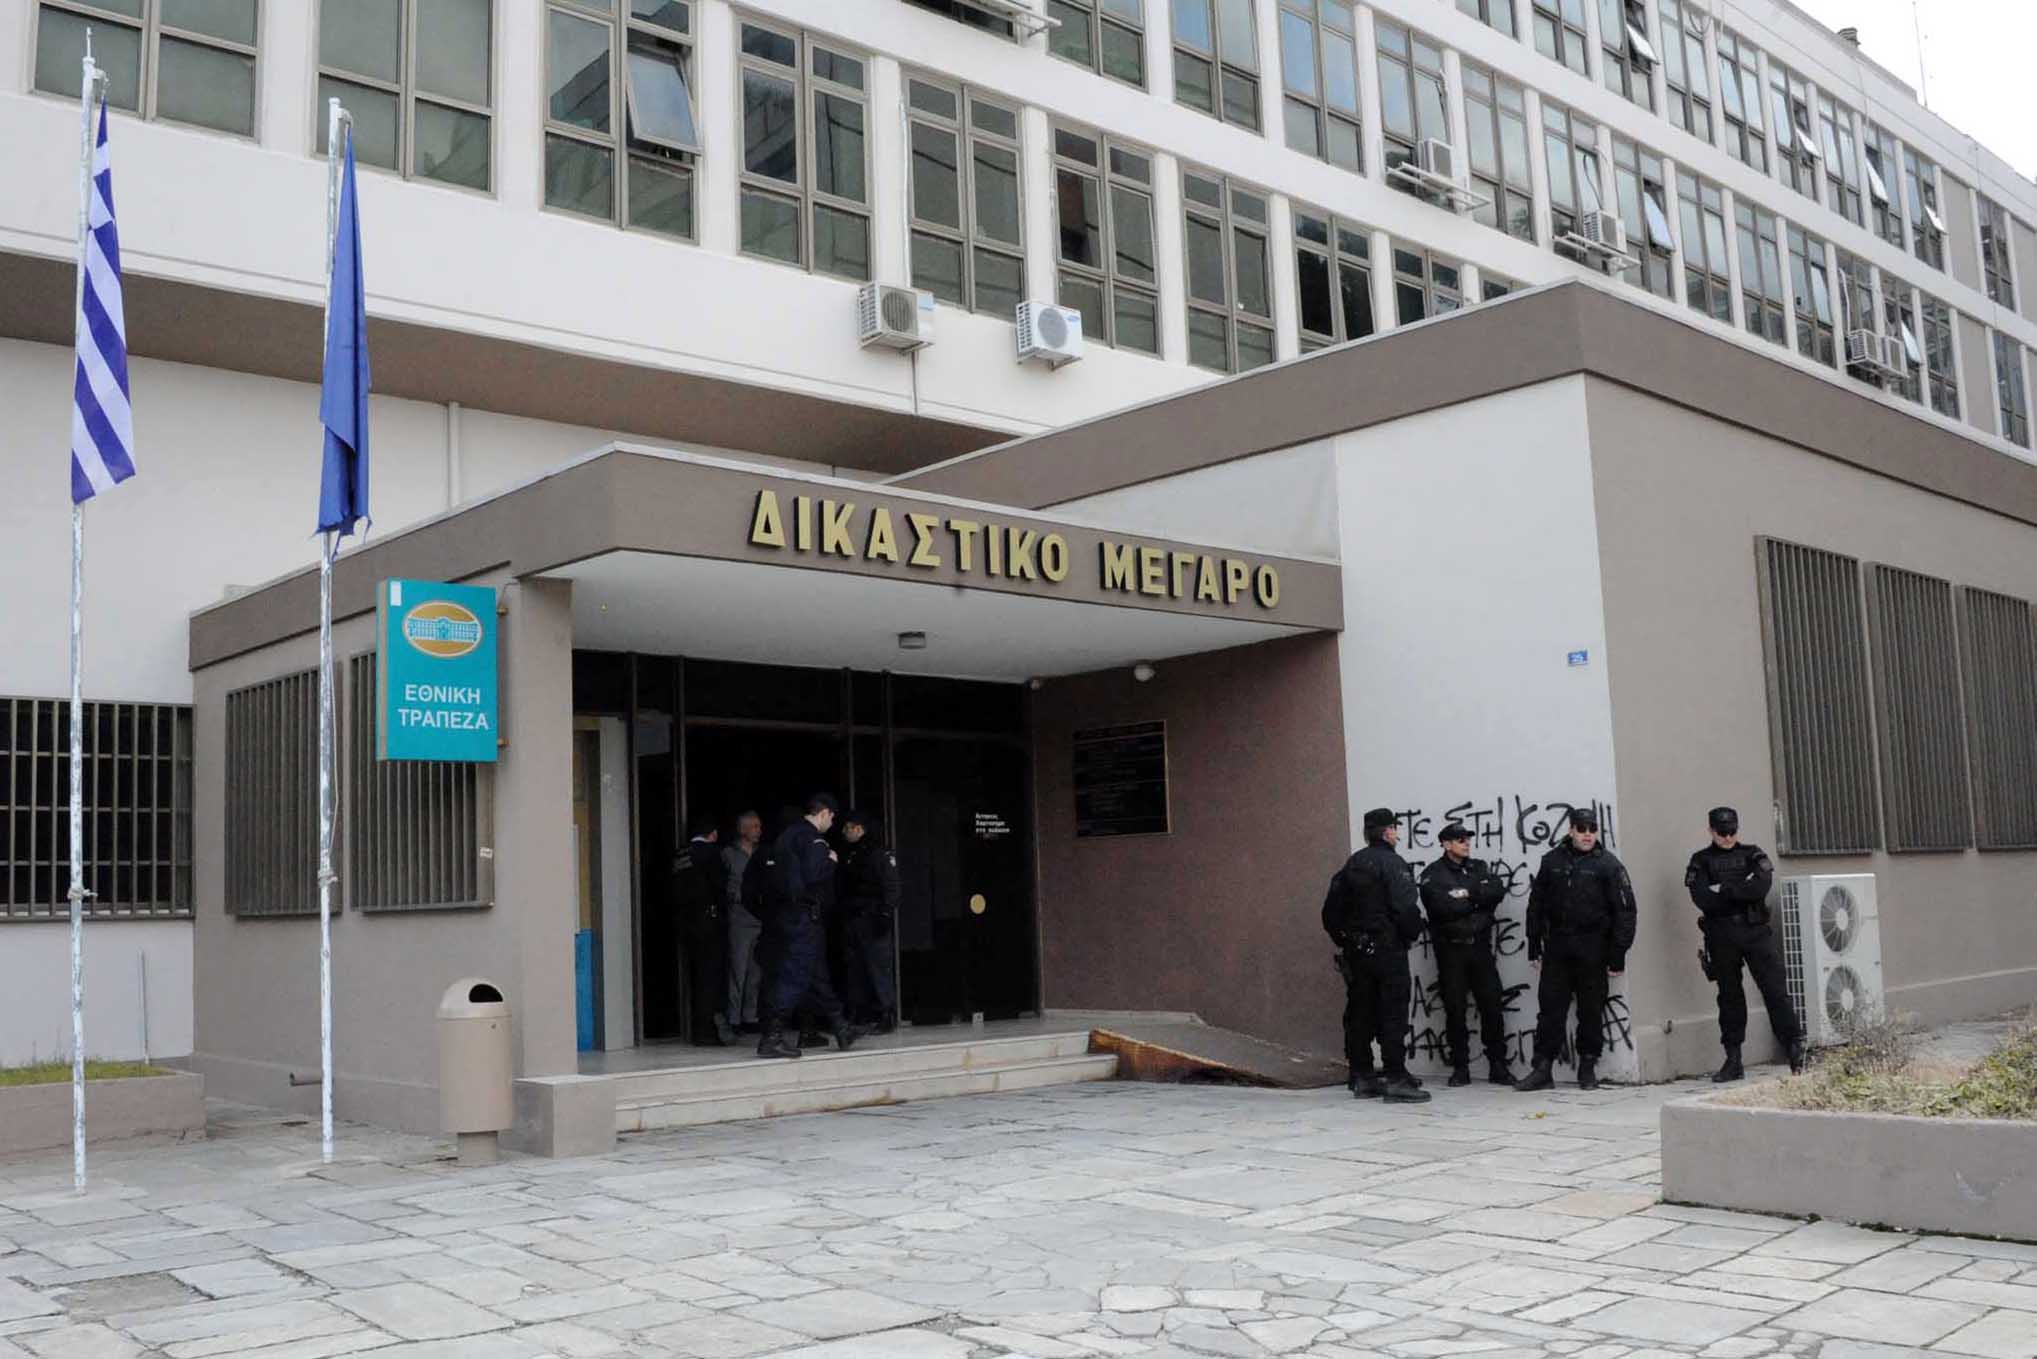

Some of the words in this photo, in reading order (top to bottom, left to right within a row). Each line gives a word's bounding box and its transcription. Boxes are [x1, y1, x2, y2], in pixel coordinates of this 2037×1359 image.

[750, 489, 1069, 582] ΔΙΚΑΣΤΙΚΟ
[1099, 541, 1280, 608] ΜΕΓΑΡΟ
[405, 684, 481, 704] ΕΘΝΙΚΗ
[398, 708, 489, 730] ΤΡΑΠΕΖΑ
